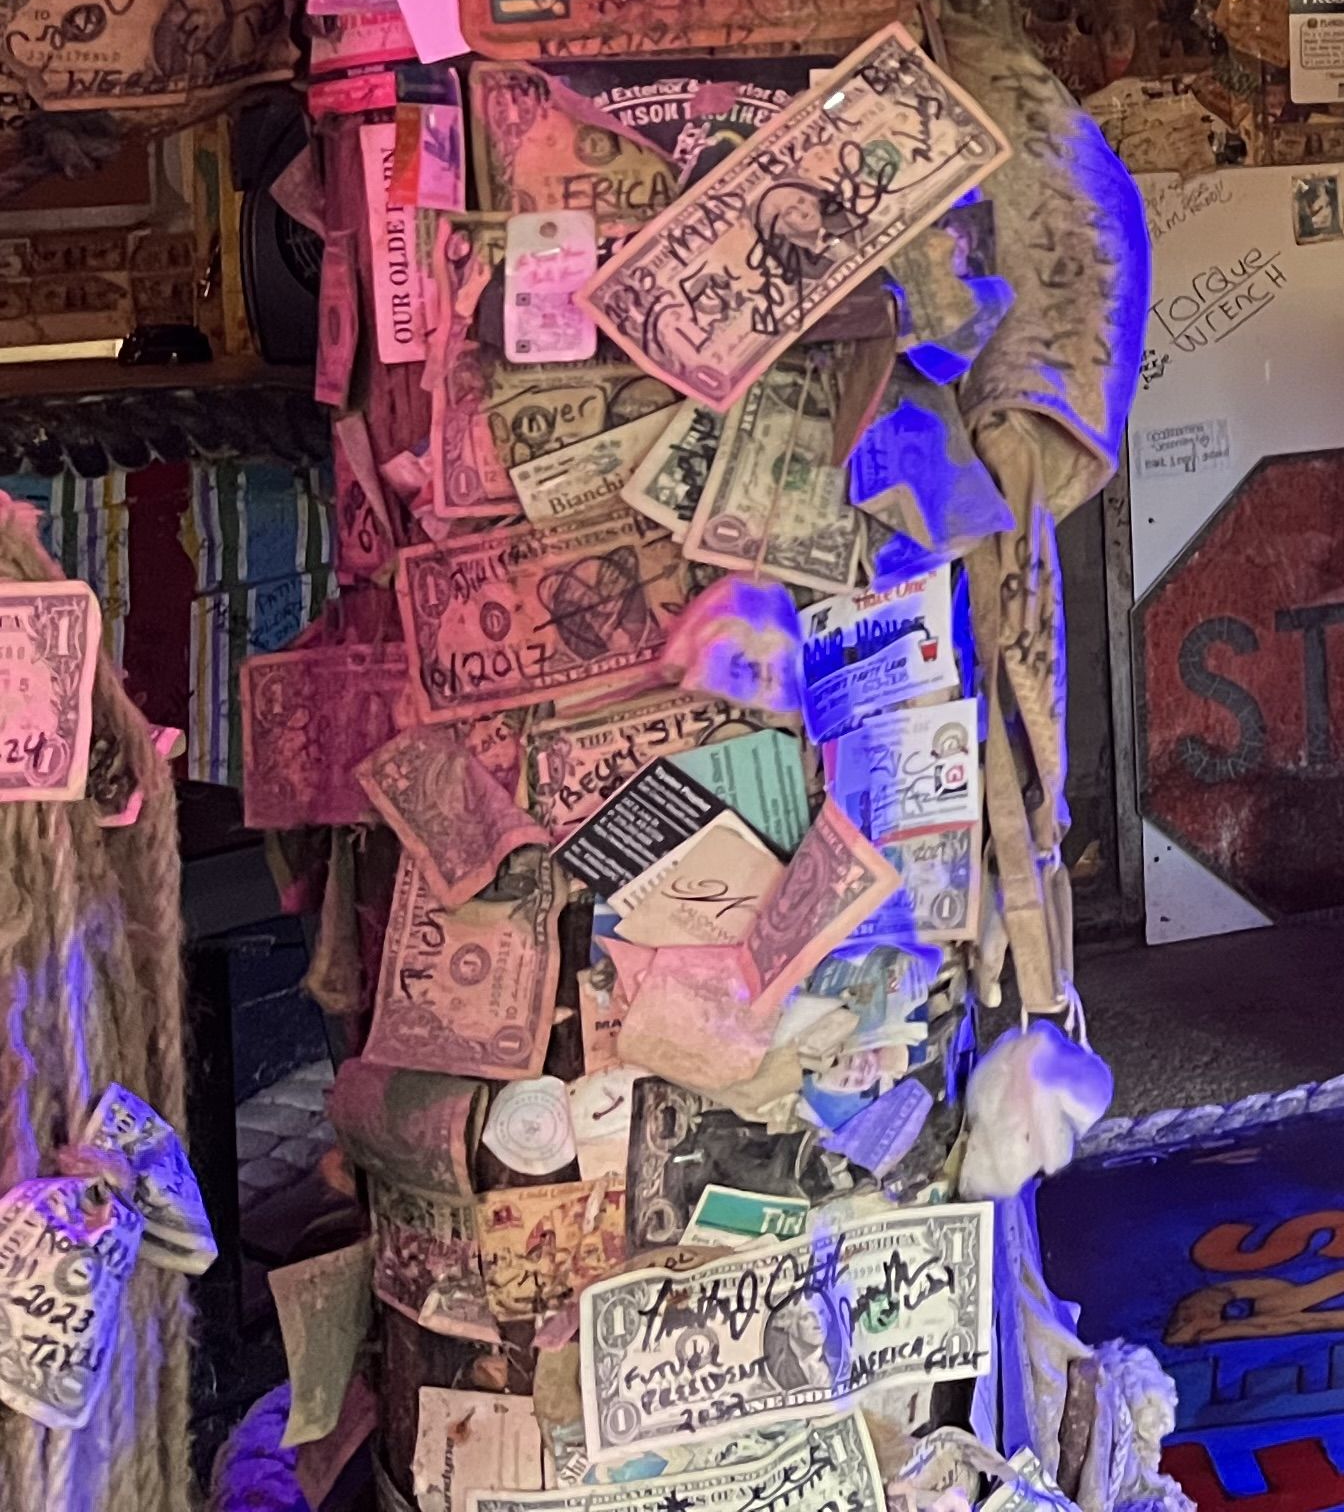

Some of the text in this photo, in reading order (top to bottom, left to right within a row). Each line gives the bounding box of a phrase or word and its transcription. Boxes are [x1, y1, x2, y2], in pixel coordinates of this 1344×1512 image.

[562, 173, 678, 211] ERICA
[383, 220, 411, 287] OLDE
[387, 294, 415, 346] OUR
[549, 475, 626, 514] Bianchi
[11, 1284, 96, 1335] 2023
